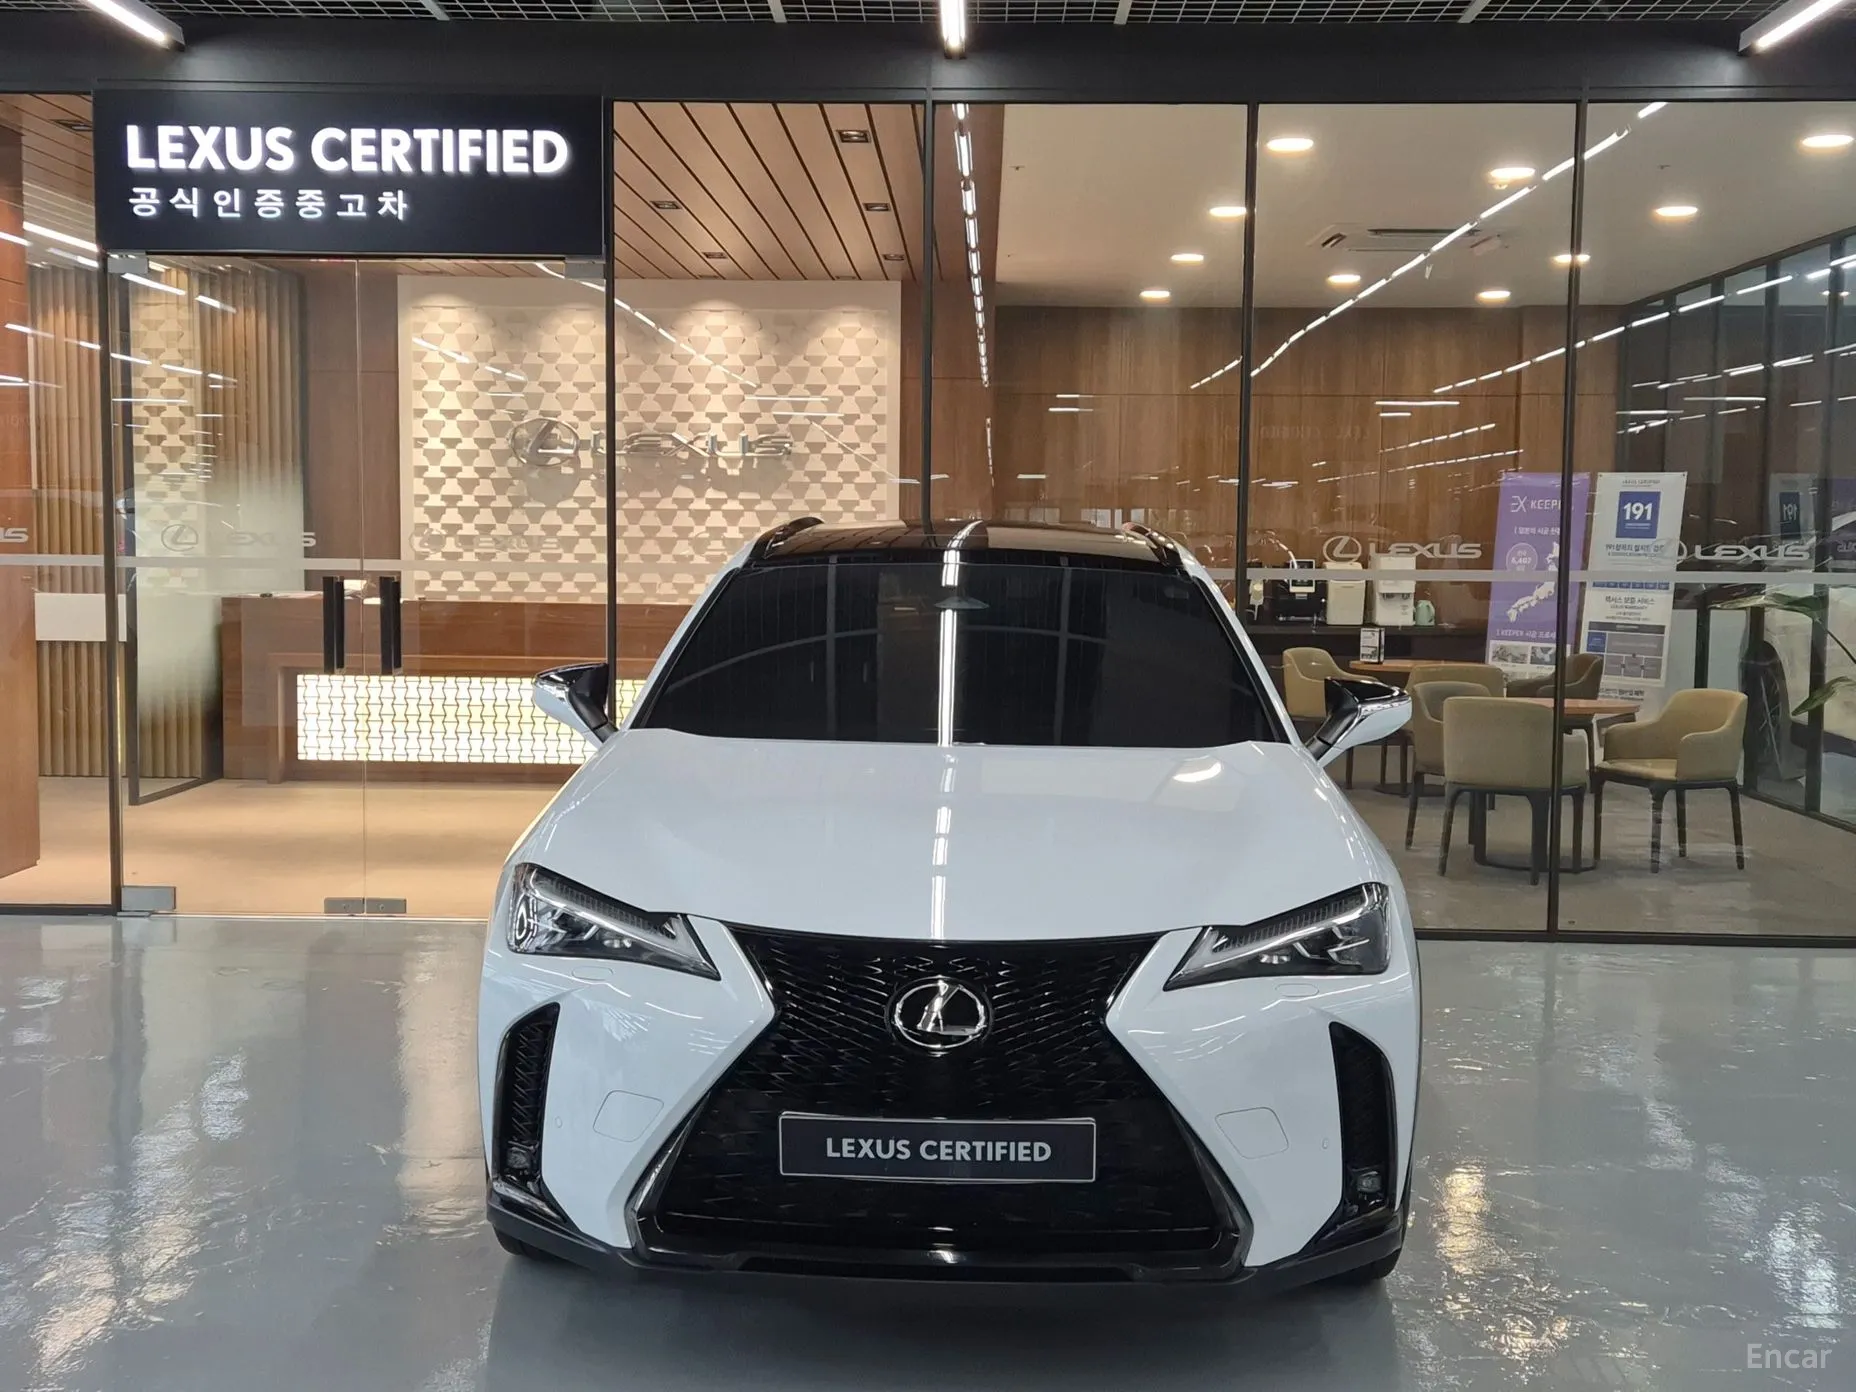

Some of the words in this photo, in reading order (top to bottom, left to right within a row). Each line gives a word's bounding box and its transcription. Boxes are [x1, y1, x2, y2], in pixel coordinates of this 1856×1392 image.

[125, 124, 295, 173] LEXUS
[310, 127, 569, 175] CERTIFIED
[129, 187, 408, 219] 공식인증중고차
[1530, 499, 1562, 510] KEEP
[1623, 502, 1653, 520] 191
[1369, 542, 1482, 559] LEXUS
[1694, 544, 1810, 561] LEXUS
[826, 1137, 911, 1160] LEXUS
[919, 1140, 1052, 1162] CERTIFIED
